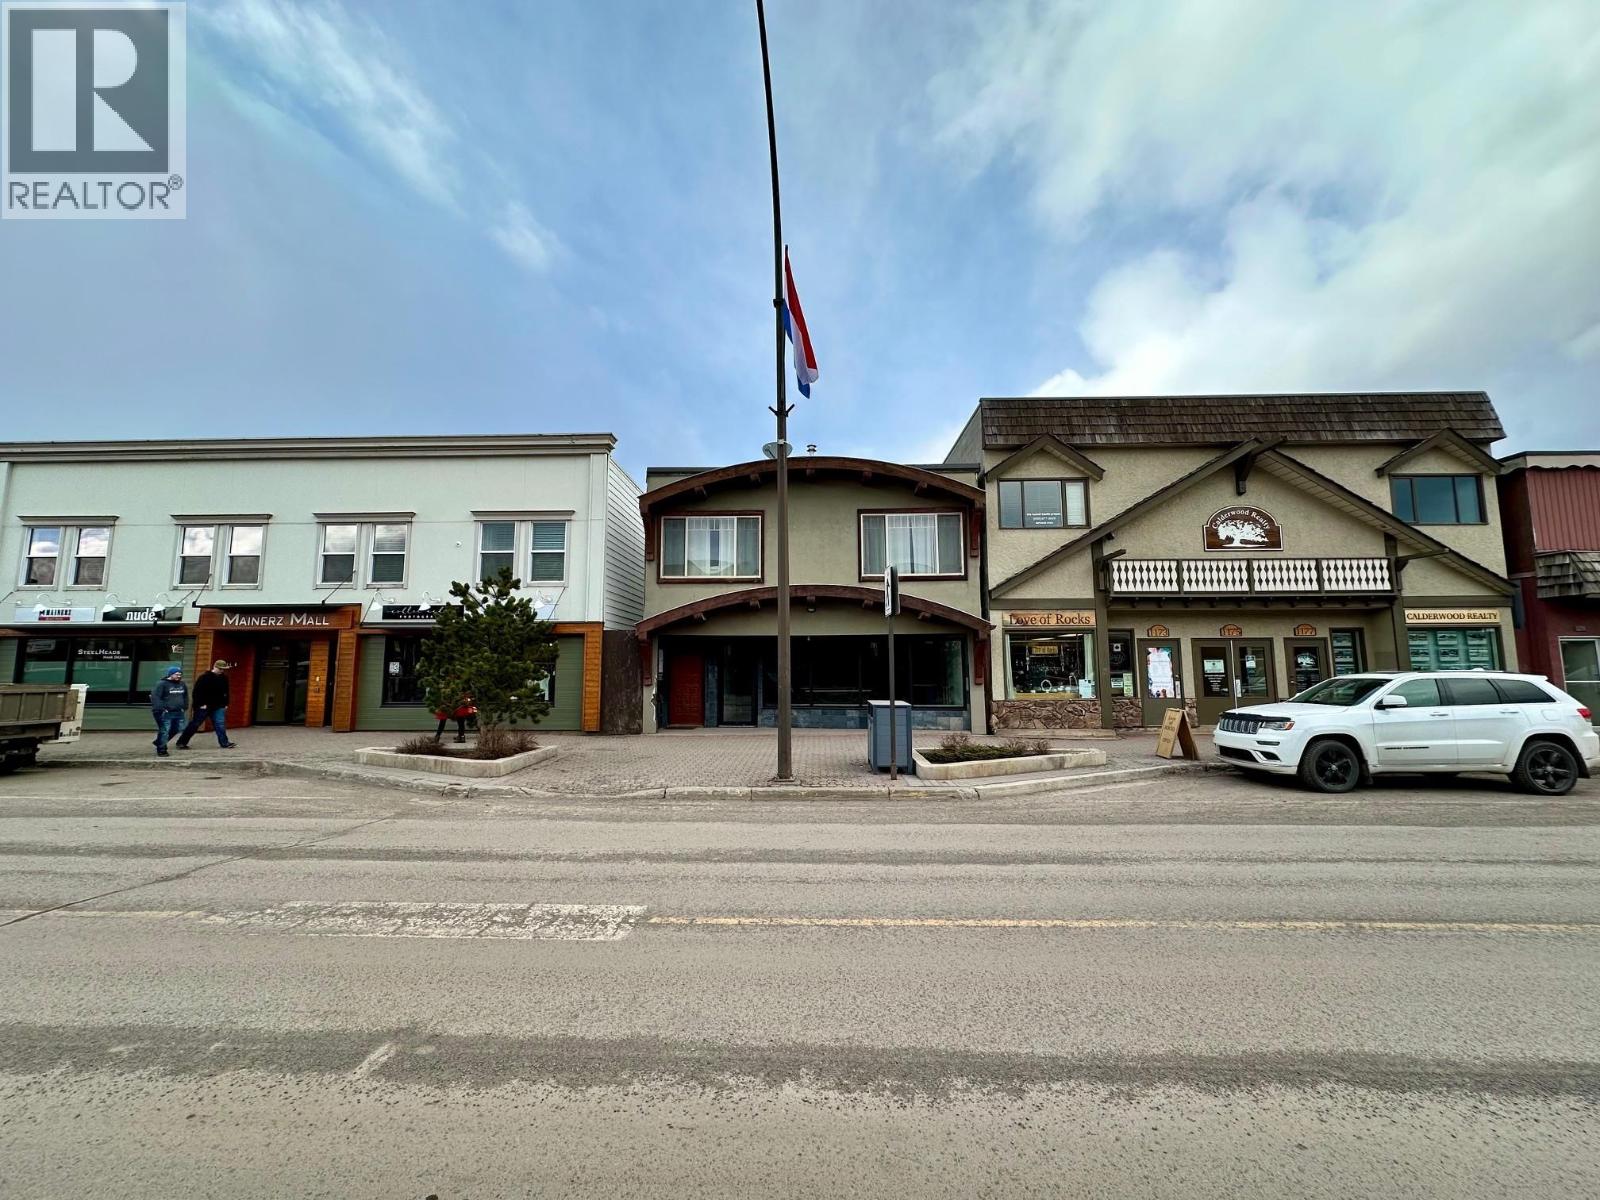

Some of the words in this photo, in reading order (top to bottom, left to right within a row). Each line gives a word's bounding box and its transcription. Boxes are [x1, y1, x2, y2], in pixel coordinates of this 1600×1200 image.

[1211, 509, 1250, 529] Calderwood
[1250, 511, 1271, 530] Realty
[125, 607, 158, 621] nude.
[1009, 613, 1037, 624] Love
[1039, 613, 1052, 624] of
[1055, 613, 1091, 624] Rocks
[1406, 612, 1465, 621] CALDERWOOD
[1467, 612, 1498, 621] REALTY
